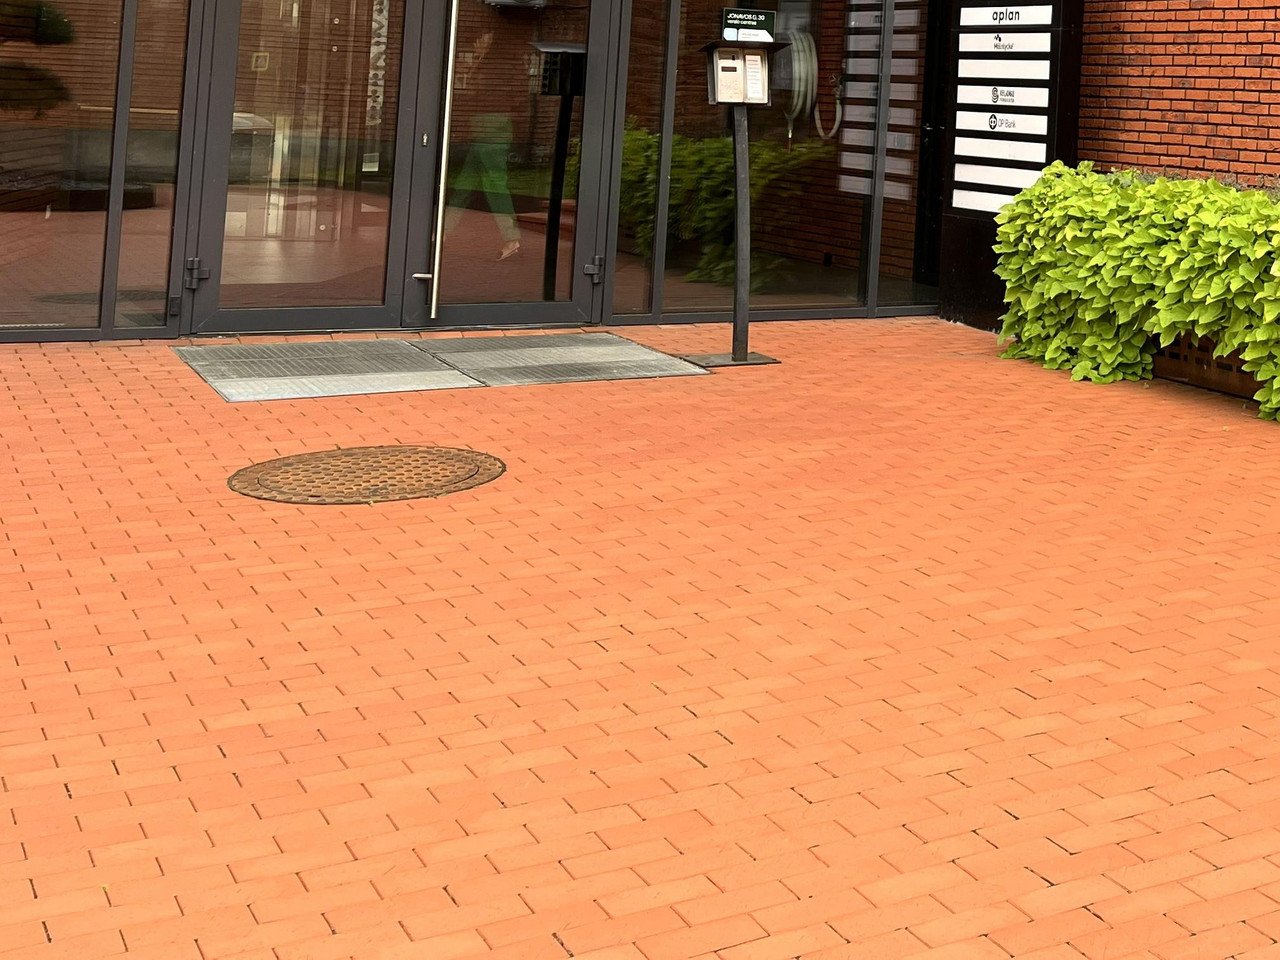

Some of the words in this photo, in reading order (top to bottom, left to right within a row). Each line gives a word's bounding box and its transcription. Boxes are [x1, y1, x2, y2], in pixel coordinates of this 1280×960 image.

[727, 12, 752, 20] JONAVOS
[992, 8, 1020, 24] aplan
[1005, 119, 1016, 128] Bank
